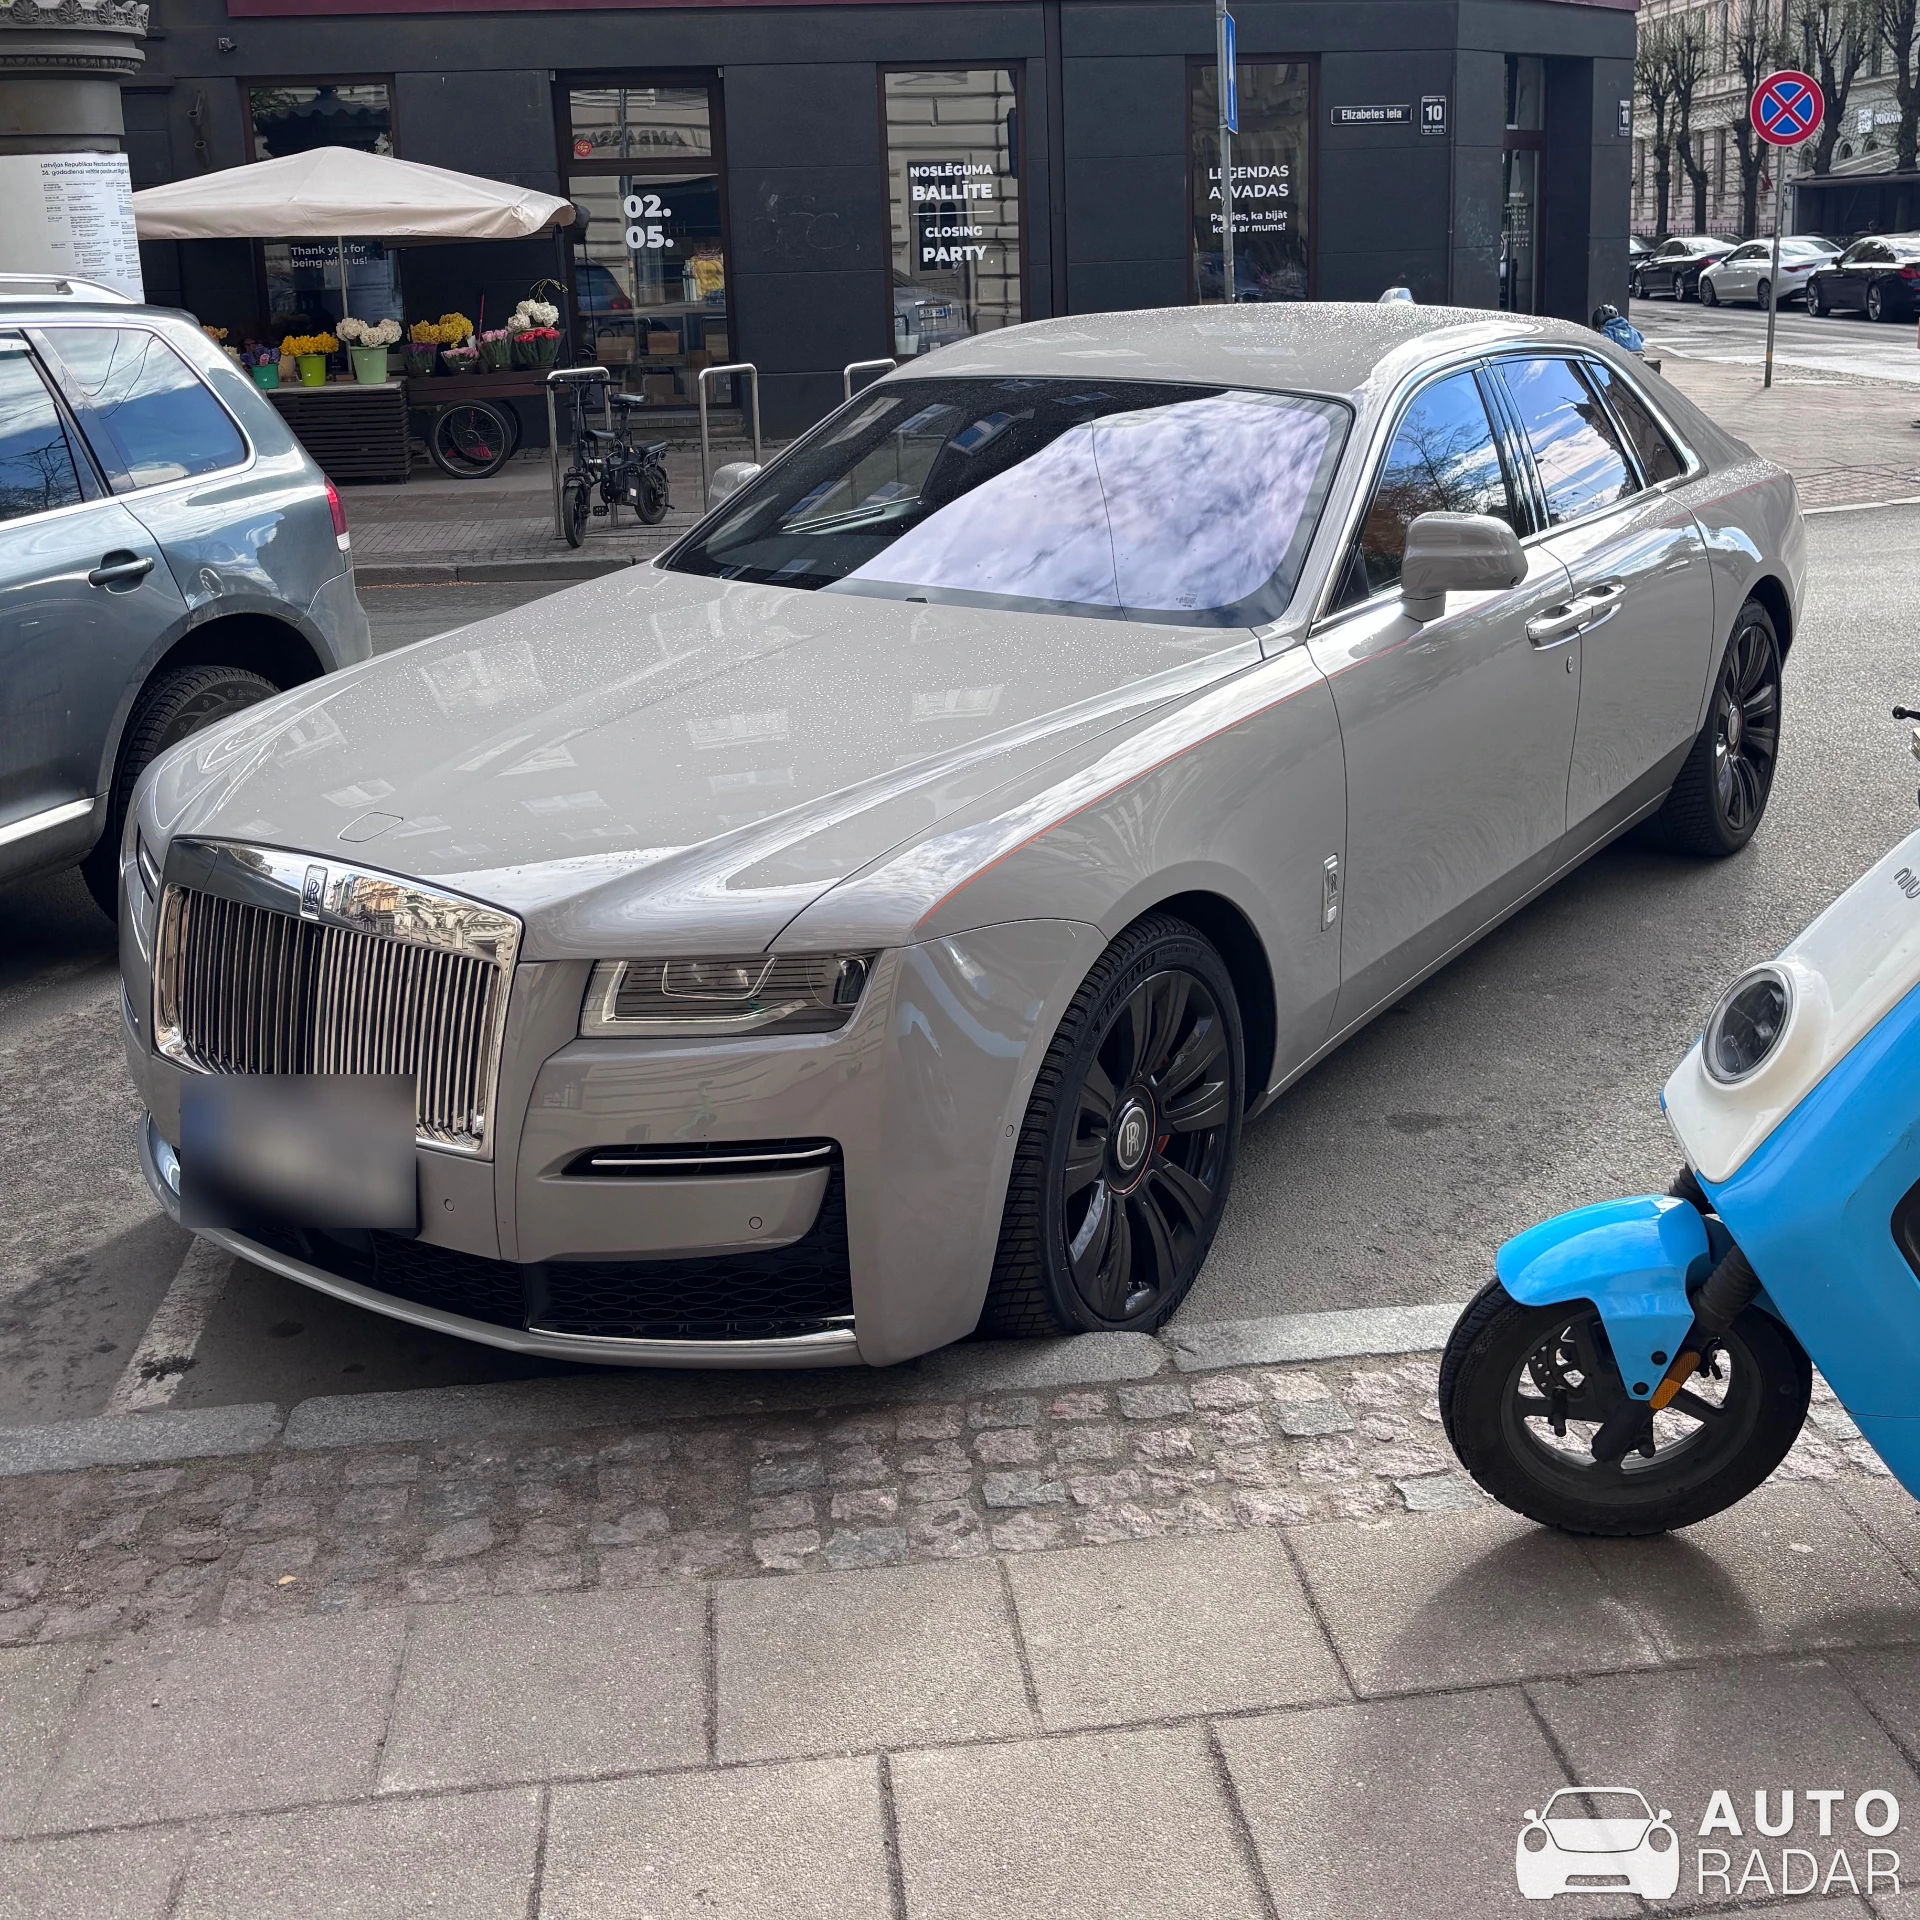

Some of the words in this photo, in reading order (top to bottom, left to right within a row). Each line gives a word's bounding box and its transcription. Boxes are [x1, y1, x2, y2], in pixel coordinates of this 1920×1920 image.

[1341, 109, 1385, 121] Elizabetes
[1386, 108, 1402, 120] iela
[1425, 104, 1443, 121] 10
[909, 163, 994, 178] NOSLĒGUMA
[912, 180, 993, 201] BALLĪTE
[1208, 184, 1290, 200] AVADAS
[623, 194, 672, 219] 02.
[1210, 211, 1249, 222] Paies,
[1251, 211, 1263, 220] ka
[1265, 210, 1288, 221] bijāt
[925, 225, 983, 238] CLOSING
[1212, 223, 1237, 234] koā
[1239, 224, 1250, 233] ar
[1251, 222, 1286, 232] mums!
[625, 225, 675, 249] 05.
[290, 245, 326, 256] Thank
[349, 244, 366, 253] for
[922, 245, 988, 263] PARTY
[291, 258, 323, 269] being
[325, 256, 350, 266] wih
[352, 256, 368, 265] us!
